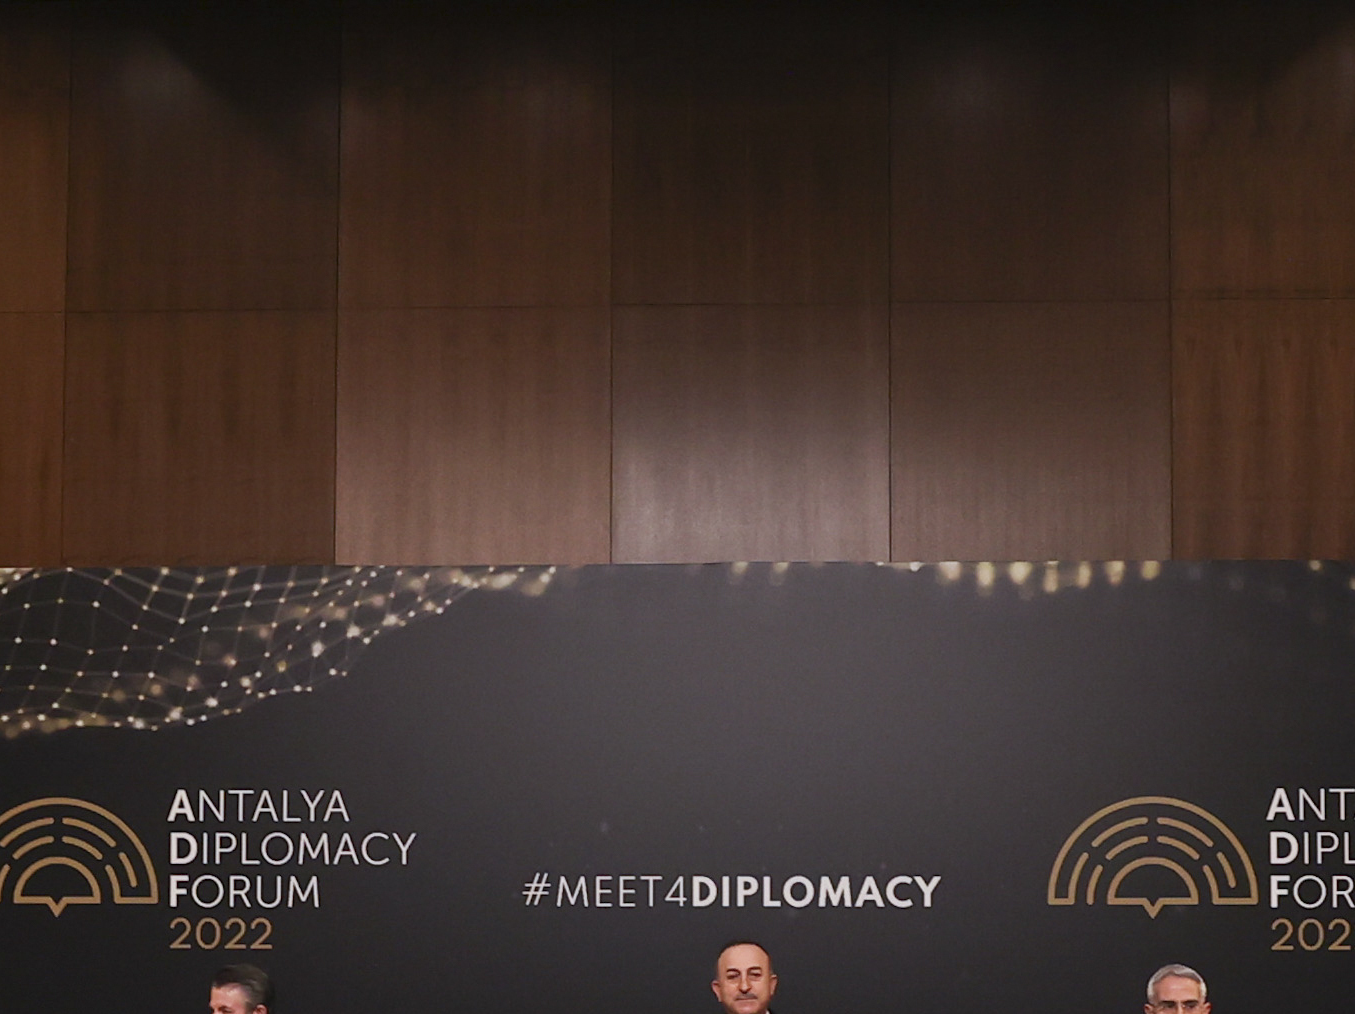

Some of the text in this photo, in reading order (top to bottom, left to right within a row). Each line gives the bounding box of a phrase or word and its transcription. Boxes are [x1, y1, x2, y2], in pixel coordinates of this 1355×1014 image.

[167, 789, 350, 823] ANTALYA
[169, 831, 417, 866] DIPLOMACY
[169, 874, 320, 909] FORUM
[522, 873, 942, 909] #MEET4DIPLOMACY
[169, 917, 273, 950] 2022
